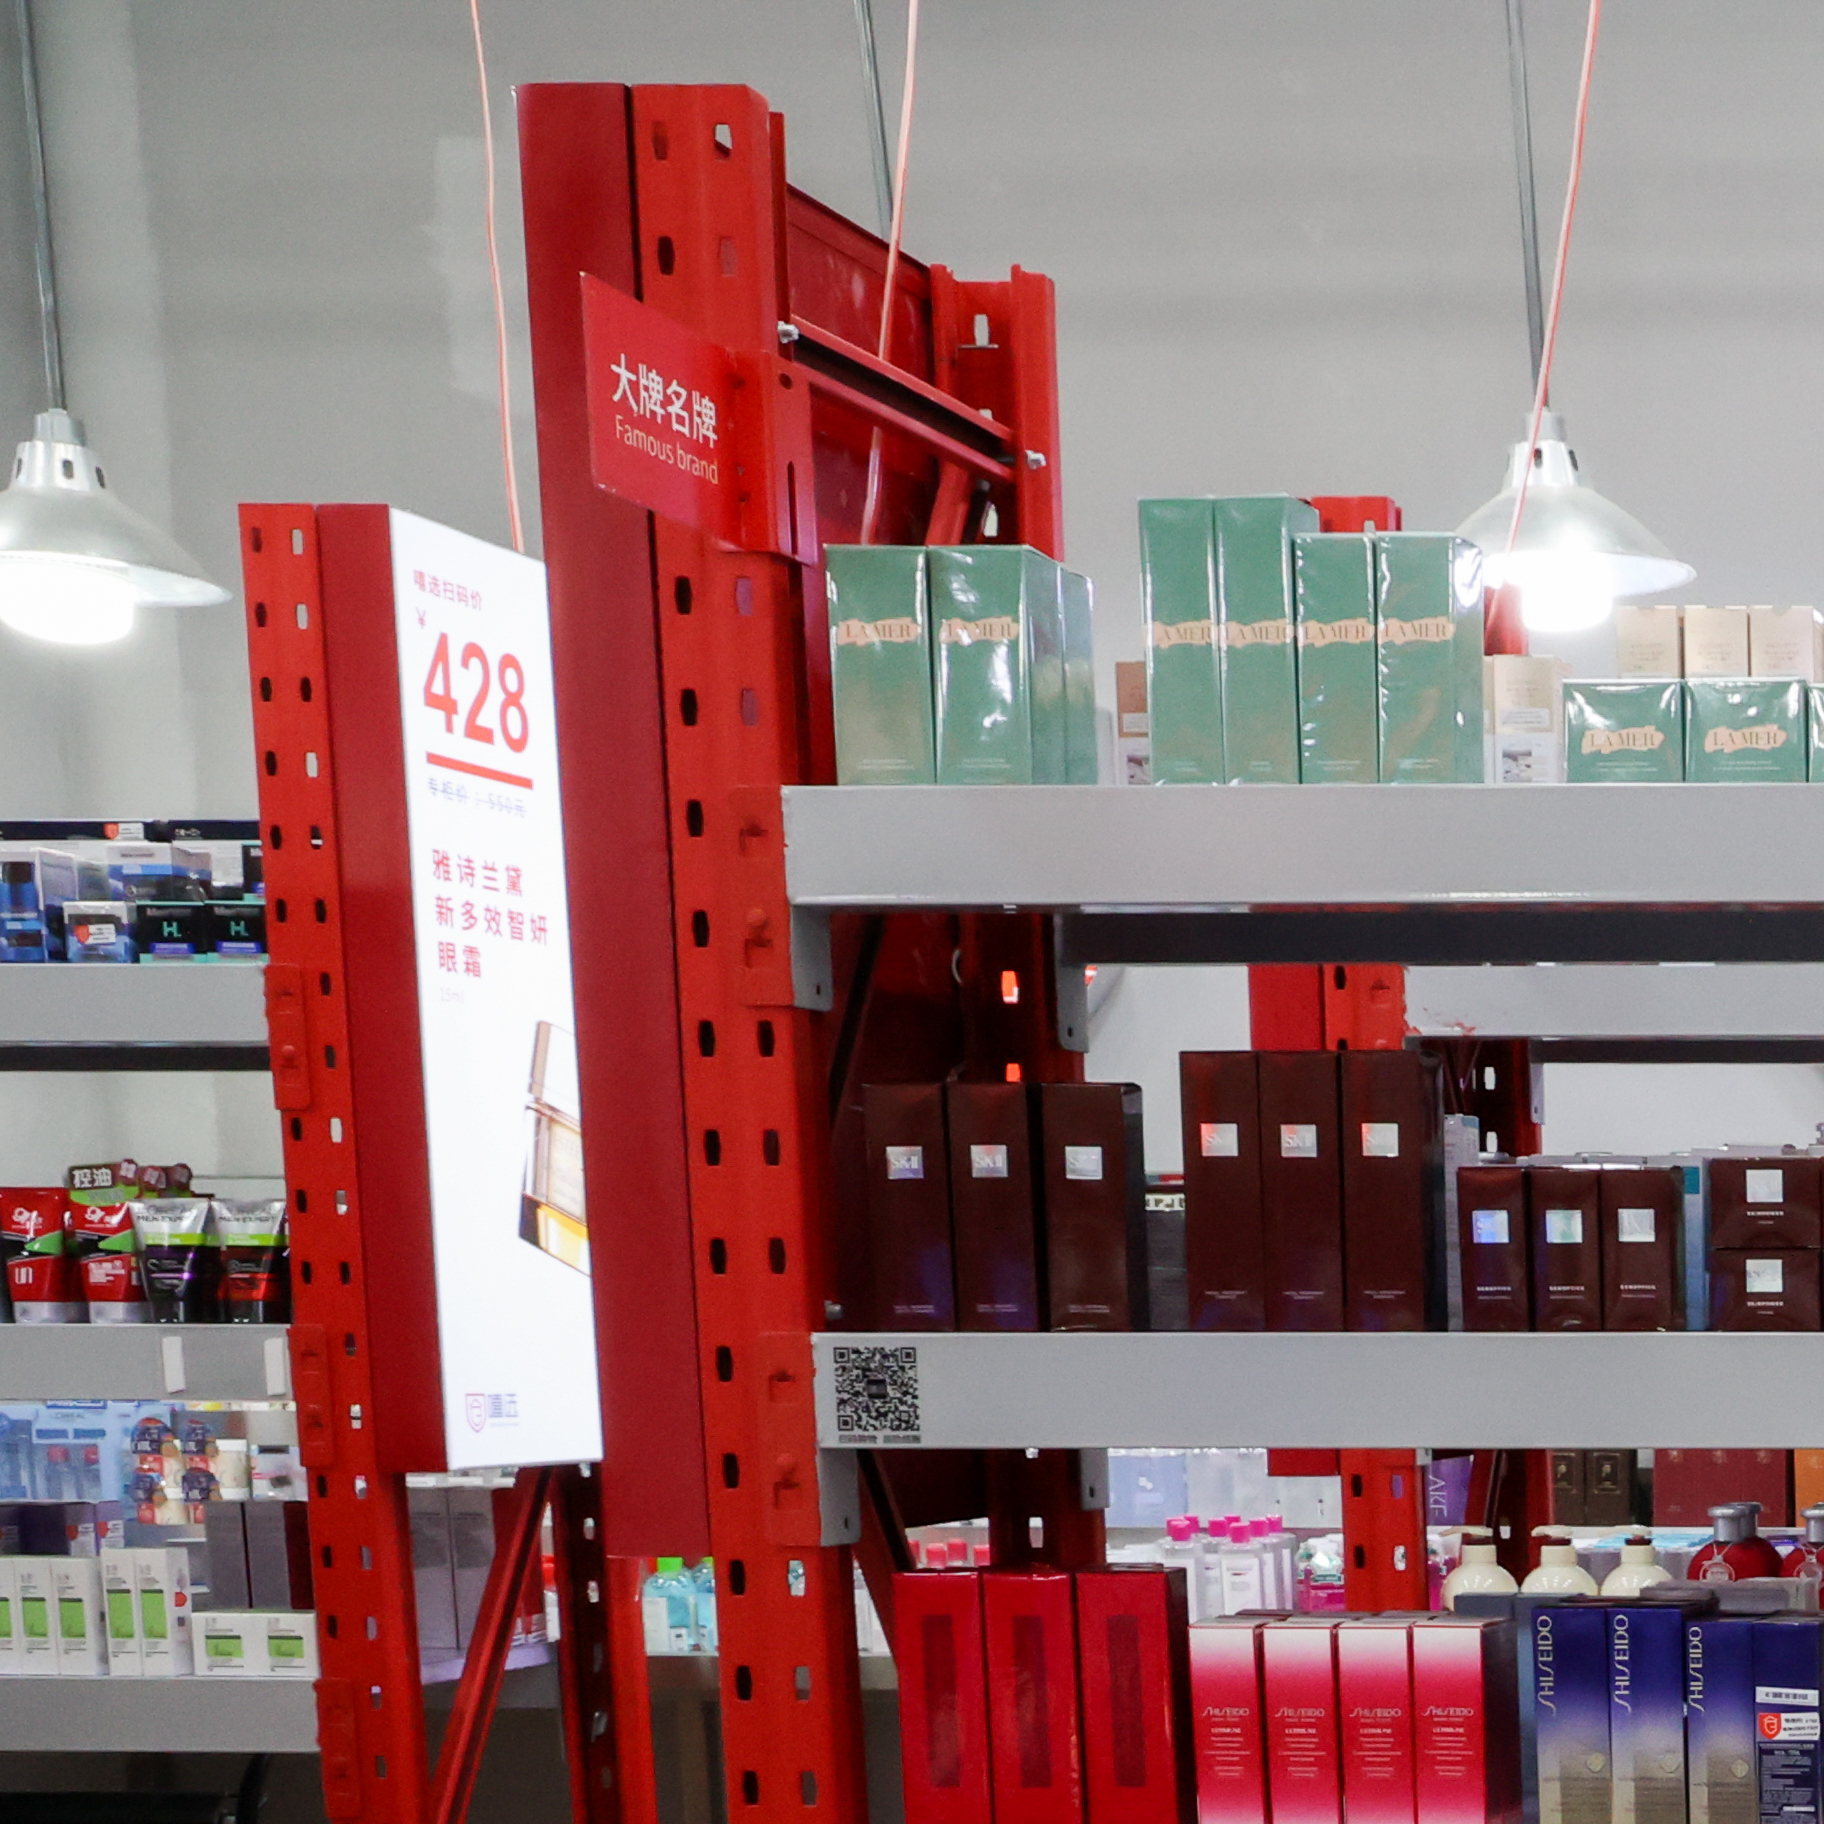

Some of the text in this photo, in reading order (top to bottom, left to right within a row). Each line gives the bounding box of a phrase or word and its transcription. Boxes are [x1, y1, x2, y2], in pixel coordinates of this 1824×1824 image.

[610, 353, 718, 448] 大牌名牌
[615, 413, 719, 485] Famous brand
[423, 631, 529, 753] 428
[432, 849, 523, 898] 雅诗兰黛
[435, 895, 549, 947] 新多效智妍
[438, 941, 483, 979] 眼霜
[1538, 1615, 1556, 1715] SHISEIDO
[1614, 1614, 1632, 1713] SHISEIDO
[1687, 1627, 1704, 1712] SHISEIDO
[1202, 1706, 1249, 1718] SHISEIDO
[1275, 1707, 1325, 1718] SHISEIDO
[1350, 1707, 1401, 1718] SHISEIDO
[1422, 1706, 1474, 1718] SHISEIDO
